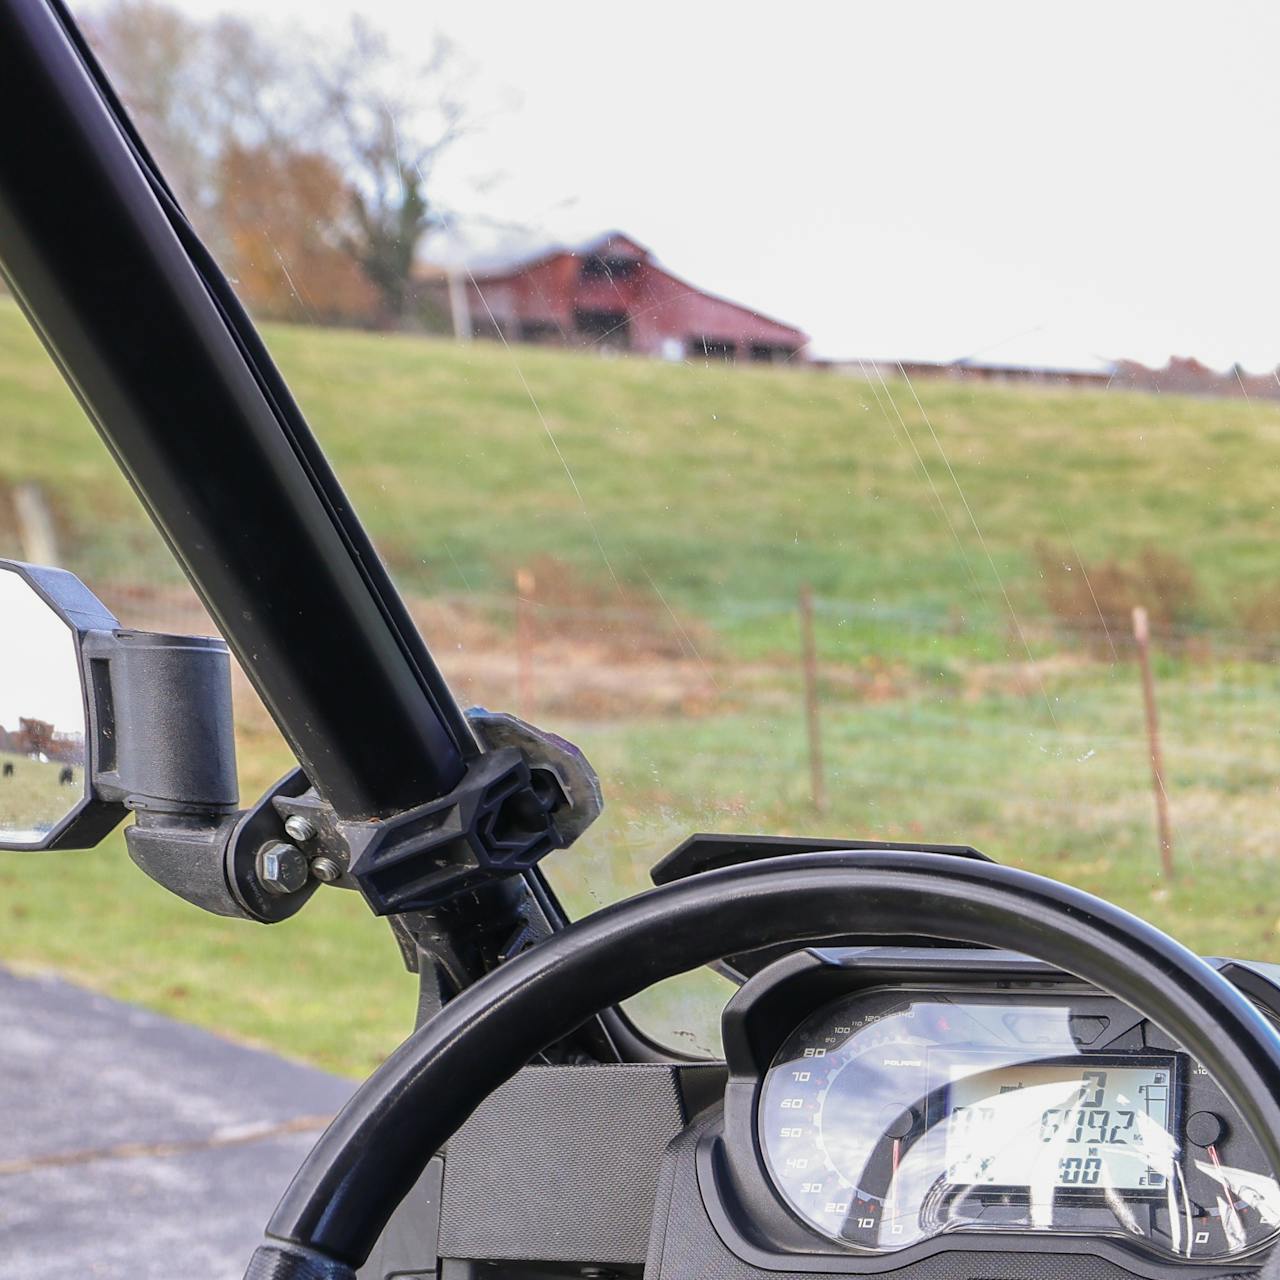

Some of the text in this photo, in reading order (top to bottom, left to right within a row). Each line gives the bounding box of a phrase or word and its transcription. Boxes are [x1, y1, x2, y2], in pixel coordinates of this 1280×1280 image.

[803, 1048, 826, 1058] 80
[791, 1071, 811, 1082] 70
[780, 1098, 803, 1109] 60
[780, 1127, 802, 1137] 50
[786, 1159, 808, 1169] 40
[1138, 1177, 1147, 1186] E
[800, 1183, 822, 1193] 30
[825, 1203, 848, 1213] 20
[857, 1218, 874, 1228] 10
[891, 1225, 903, 1234] 0
[1195, 1232, 1209, 1243] 0
